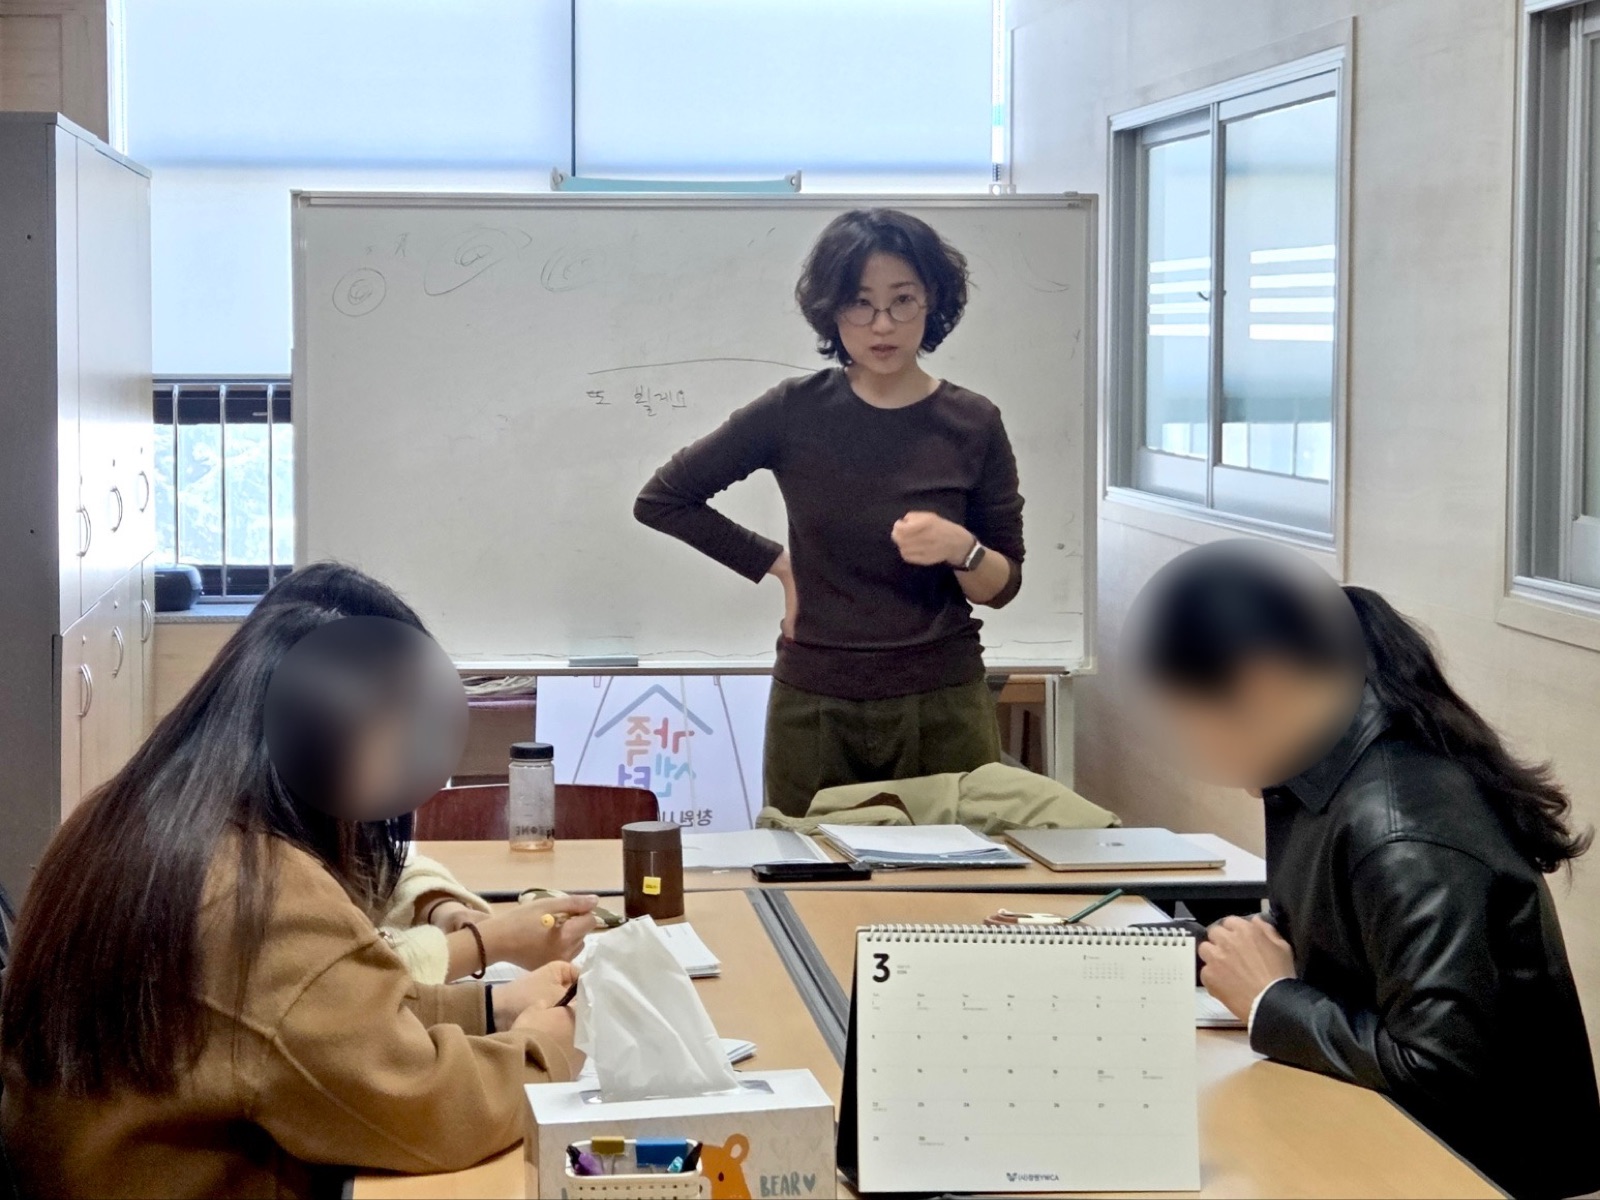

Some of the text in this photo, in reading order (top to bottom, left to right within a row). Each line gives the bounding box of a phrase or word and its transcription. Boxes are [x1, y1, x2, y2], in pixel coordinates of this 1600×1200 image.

[586, 390, 612, 405] 또
[872, 953, 891, 983] 3
[760, 1171, 801, 1197] BEAR
